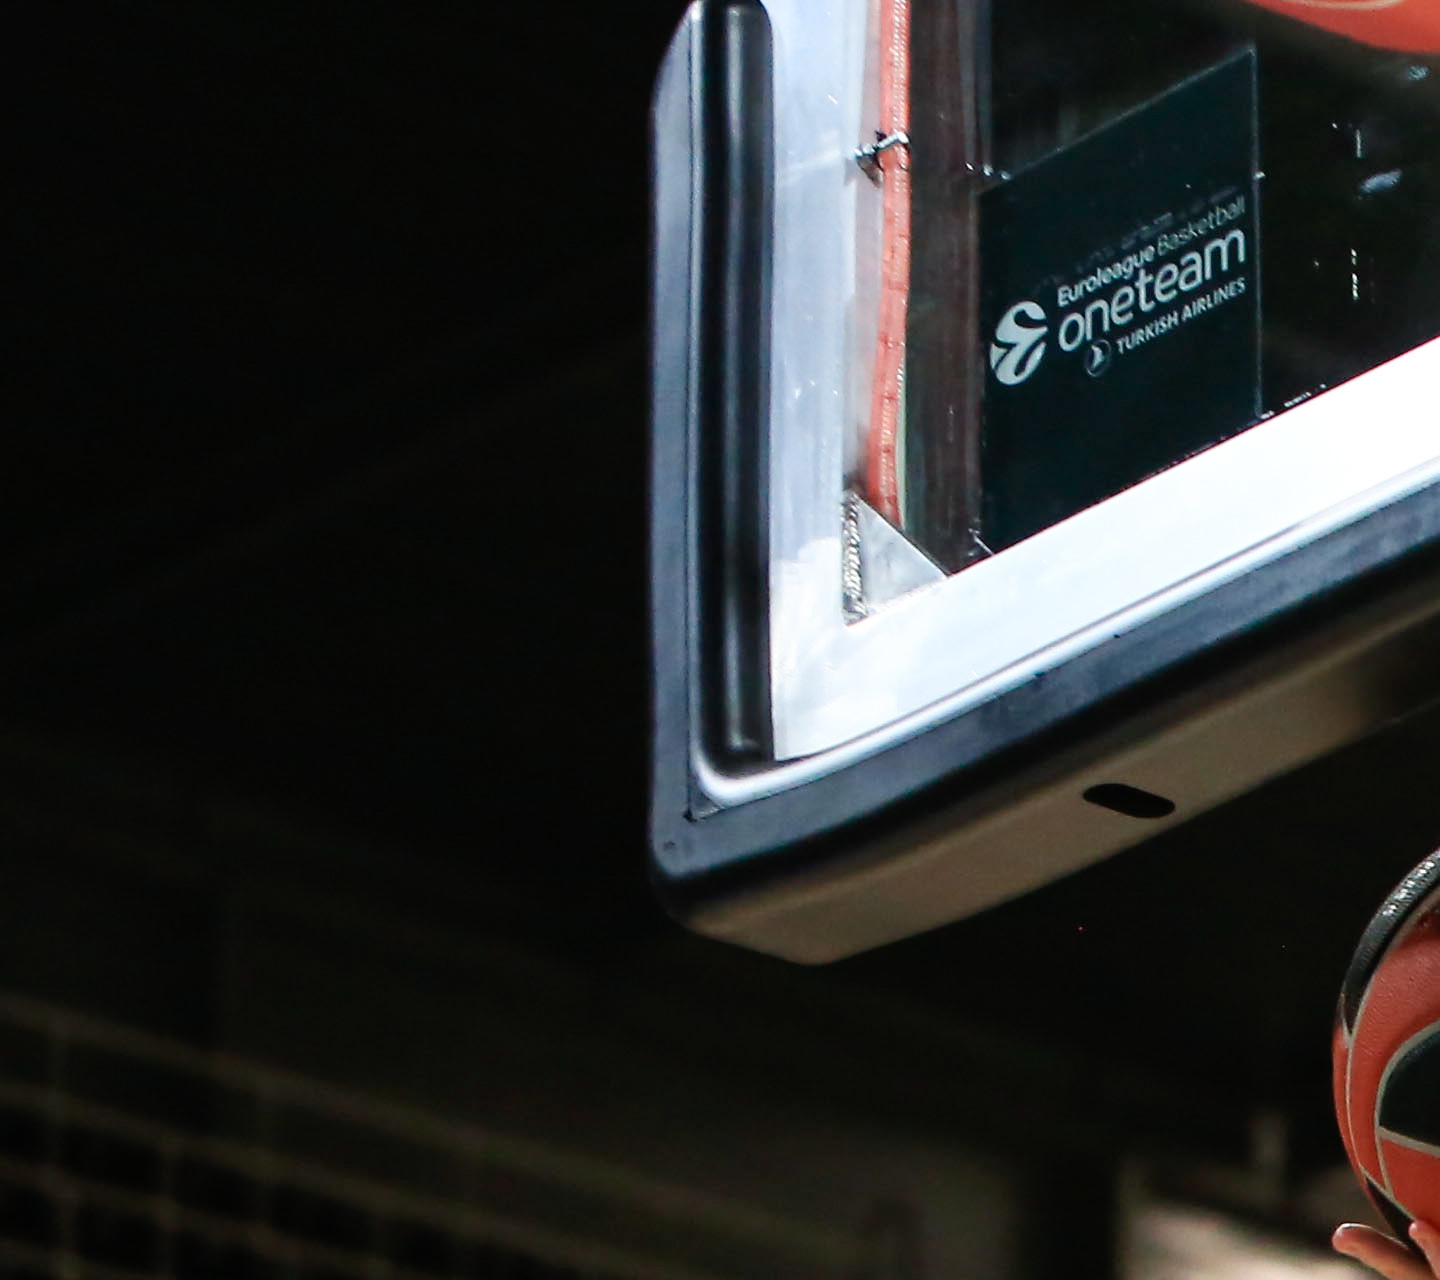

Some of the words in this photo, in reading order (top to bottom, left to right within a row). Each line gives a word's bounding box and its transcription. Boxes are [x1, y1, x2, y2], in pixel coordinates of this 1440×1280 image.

[1057, 245, 1155, 307] Euroleague
[1157, 195, 1246, 256] Basketball
[1058, 228, 1246, 352] oneteam
[1115, 310, 1179, 355] TURKISH
[1181, 277, 1247, 323] AIRLINES
